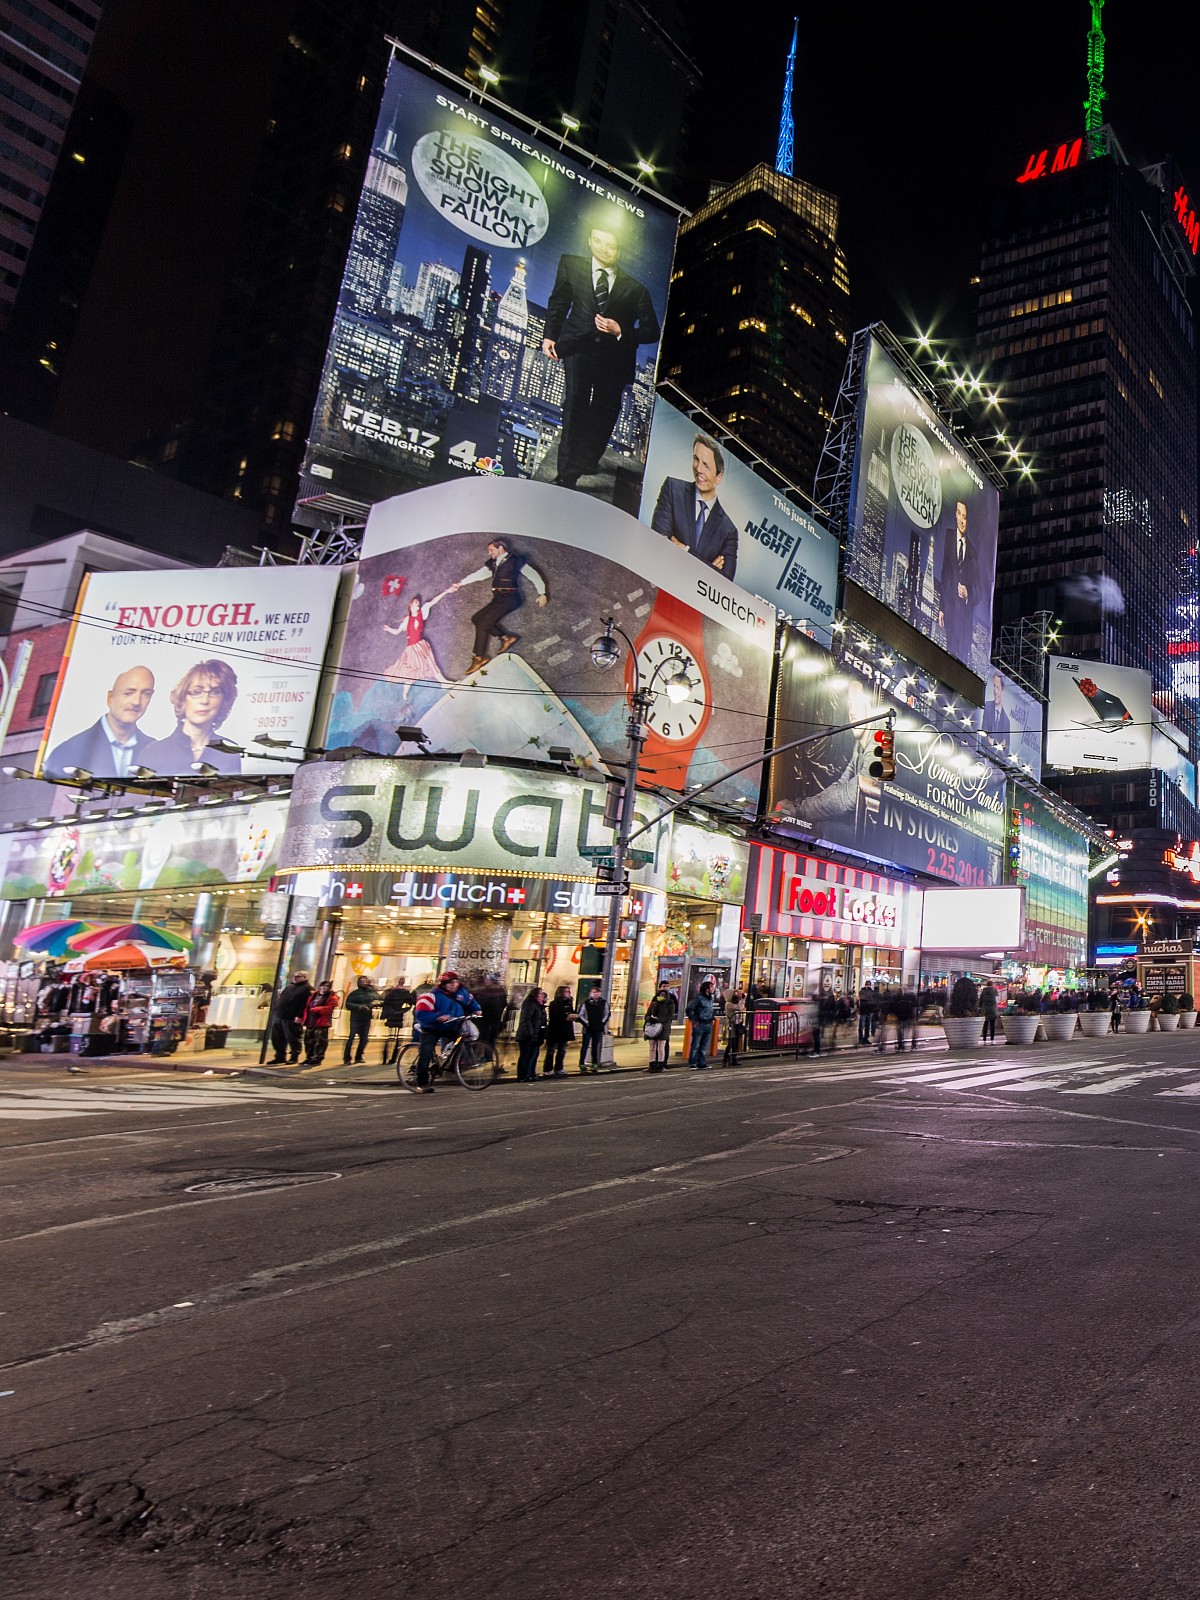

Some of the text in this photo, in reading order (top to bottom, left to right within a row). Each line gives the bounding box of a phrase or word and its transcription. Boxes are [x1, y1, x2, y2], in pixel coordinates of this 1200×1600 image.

[435, 94, 645, 218] START SPREADING THE NEWS
[440, 130, 482, 165] THE
[430, 158, 507, 207] SHOW
[434, 141, 539, 209] TONIGHT
[440, 193, 529, 248] FALLON
[458, 191, 536, 236] JIMMY
[342, 404, 440, 448] FEB 17
[342, 420, 436, 459] WEEKNIGHTS
[899, 425, 917, 450] THE
[448, 458, 473, 472] NEW
[449, 440, 477, 466] 4
[898, 436, 939, 489] TONIGHT
[916, 406, 984, 490] SPREADING THE NEWS
[897, 451, 927, 488] SHOW
[901, 486, 934, 527] FALLON
[908, 481, 937, 512] JIMMY
[760, 517, 795, 548] LATE
[773, 494, 822, 540] This just in...
[744, 520, 791, 558] NIGHT
[788, 568, 823, 596] SETH
[793, 561, 807, 574] WITH
[696, 579, 757, 628] swatch
[784, 577, 834, 617] MEYERS
[265, 614, 280, 625] WE
[283, 612, 310, 625] NEED
[111, 634, 136, 646] YOUR
[140, 633, 164, 645] HELP
[168, 633, 180, 644] TO
[183, 632, 209, 644] STOP
[212, 632, 233, 643] GUN
[272, 681, 288, 689] TEXT
[1056, 662, 1079, 671] ASUS
[271, 706, 279, 714] TO
[662, 722, 670, 736] 6
[926, 783, 971, 820] FORMULA
[883, 803, 959, 854] IN STORES
[600, 858, 610, 867] 45
[926, 847, 984, 887] 2.25.2014
[391, 881, 506, 904] swatch
[788, 876, 836, 918] Foot
[451, 949, 504, 960] swatch
[1144, 943, 1183, 953] nuchas
